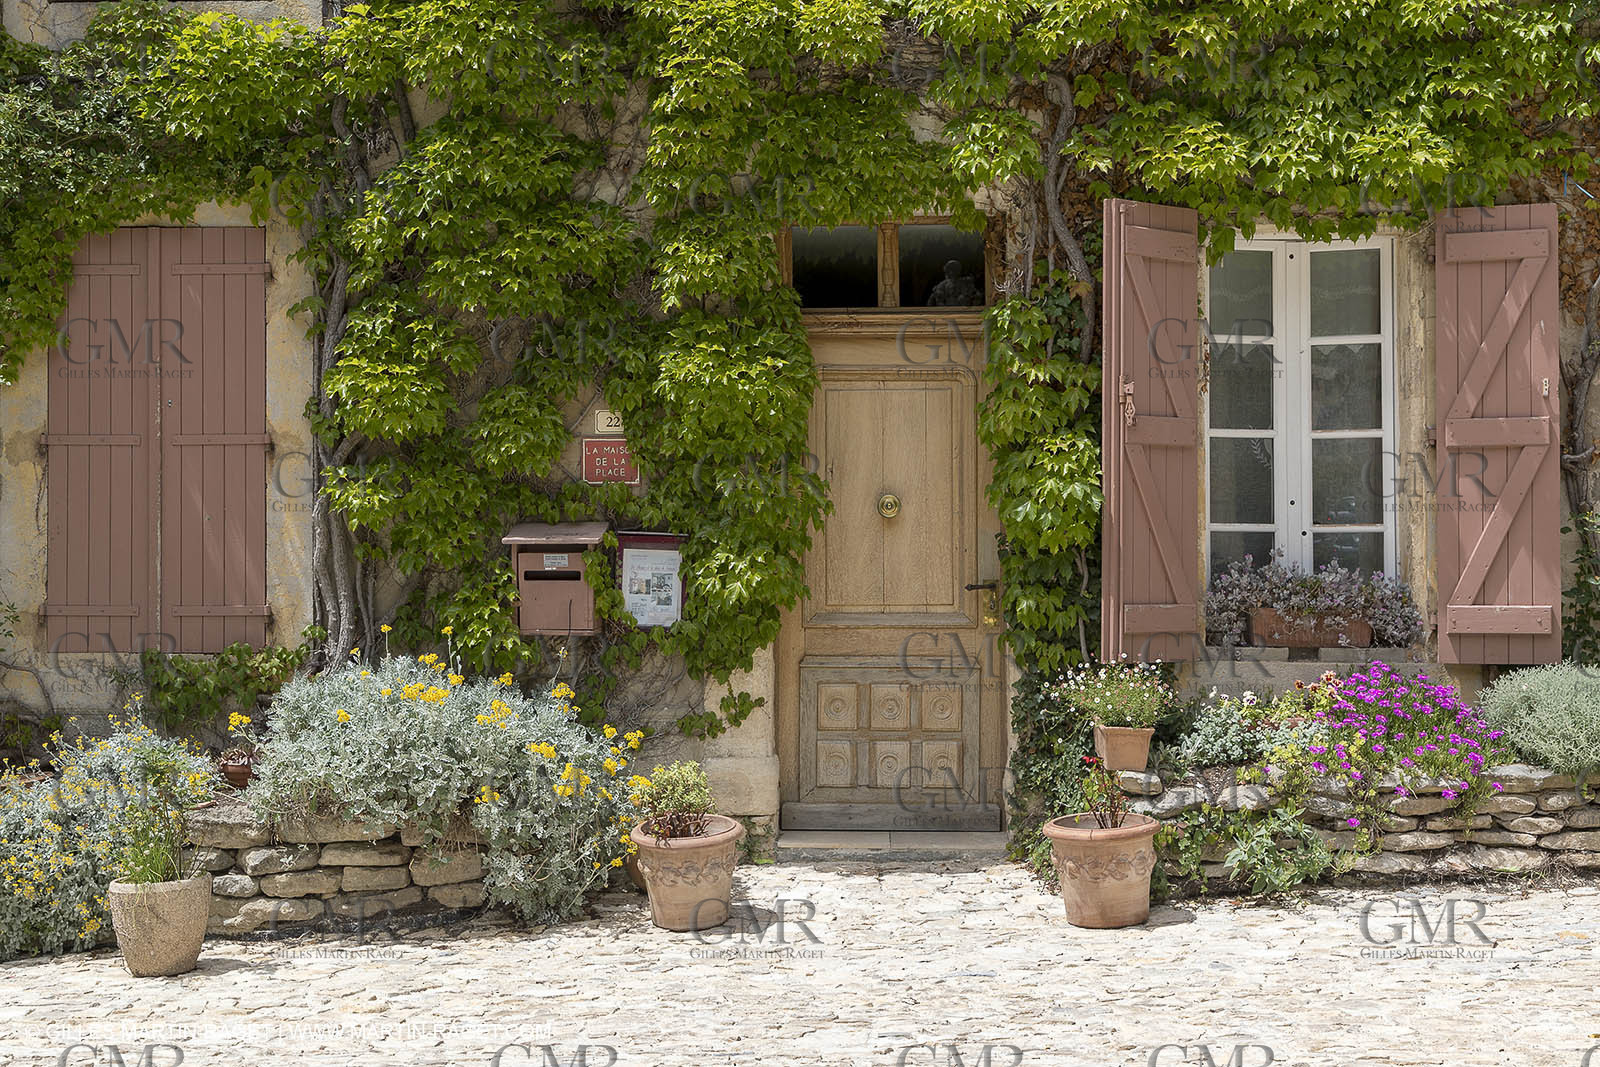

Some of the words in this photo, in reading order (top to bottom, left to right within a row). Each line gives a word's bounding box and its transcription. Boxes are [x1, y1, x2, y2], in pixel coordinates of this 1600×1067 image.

[606, 416, 620, 428] 22
[604, 446, 636, 454] MAISO
[595, 457, 607, 465] DE
[595, 468, 625, 476] PLACE
